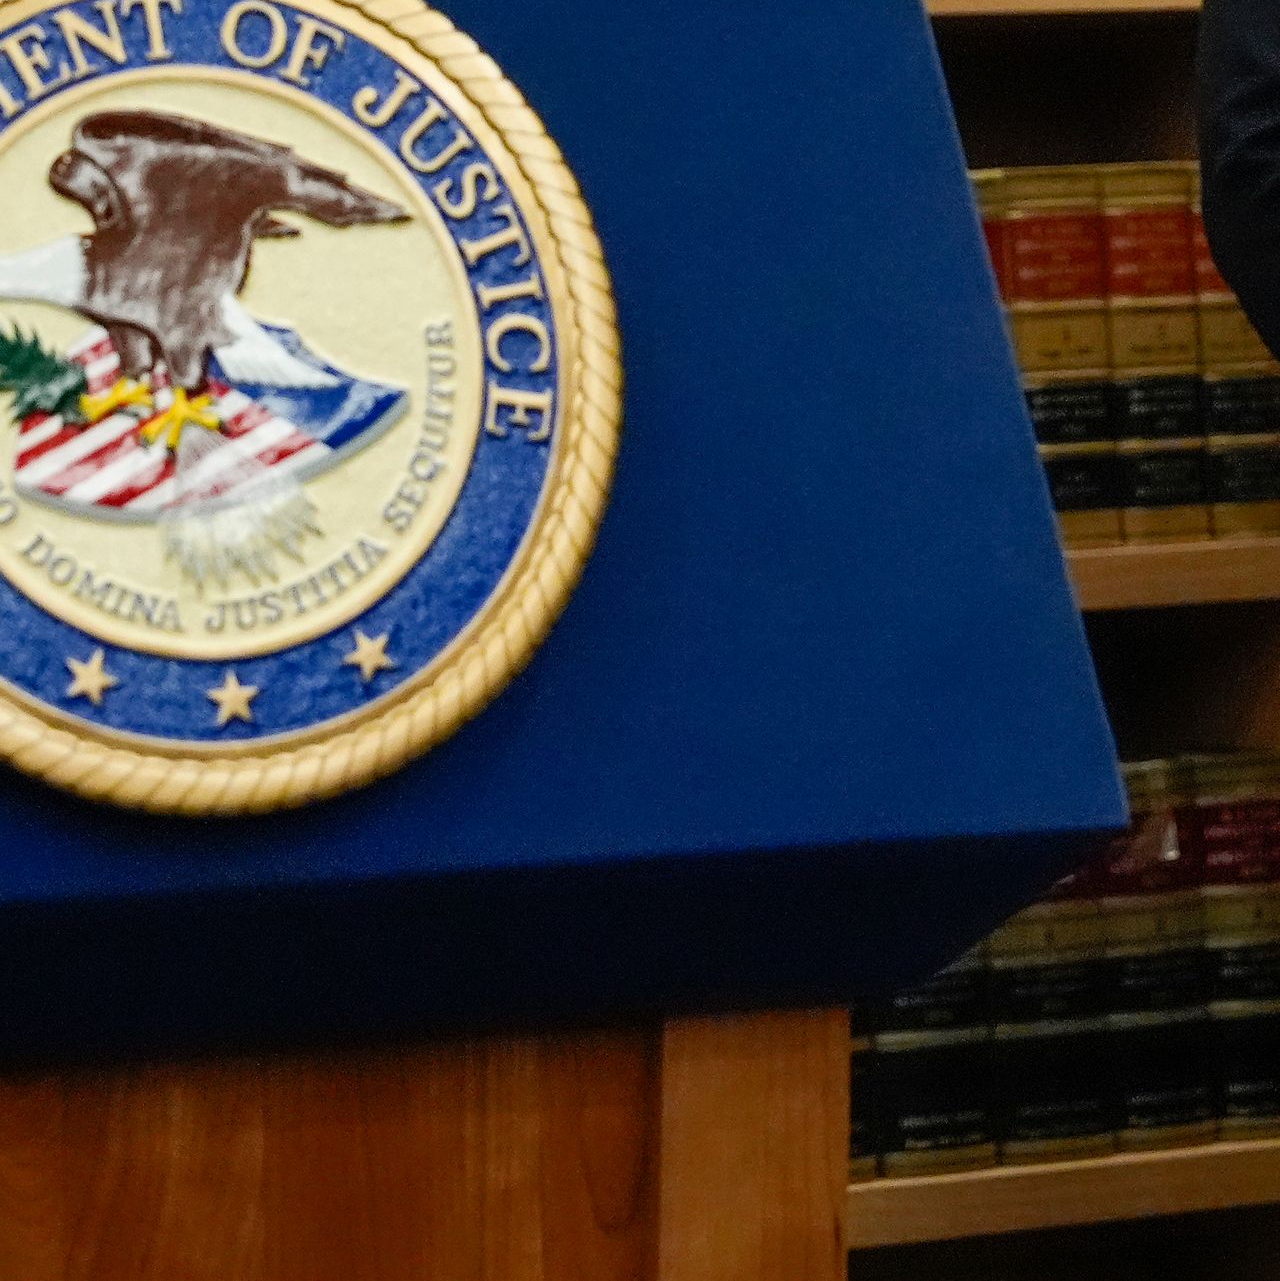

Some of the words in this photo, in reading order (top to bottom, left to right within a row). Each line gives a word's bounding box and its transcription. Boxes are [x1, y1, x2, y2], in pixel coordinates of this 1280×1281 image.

[220, 0, 346, 87] OF
[352, 69, 554, 443] JUSTICE
[21, 532, 184, 633] DOMINA
[204, 538, 391, 633] JUSTITIA
[383, 320, 457, 535] SEQUITUR
